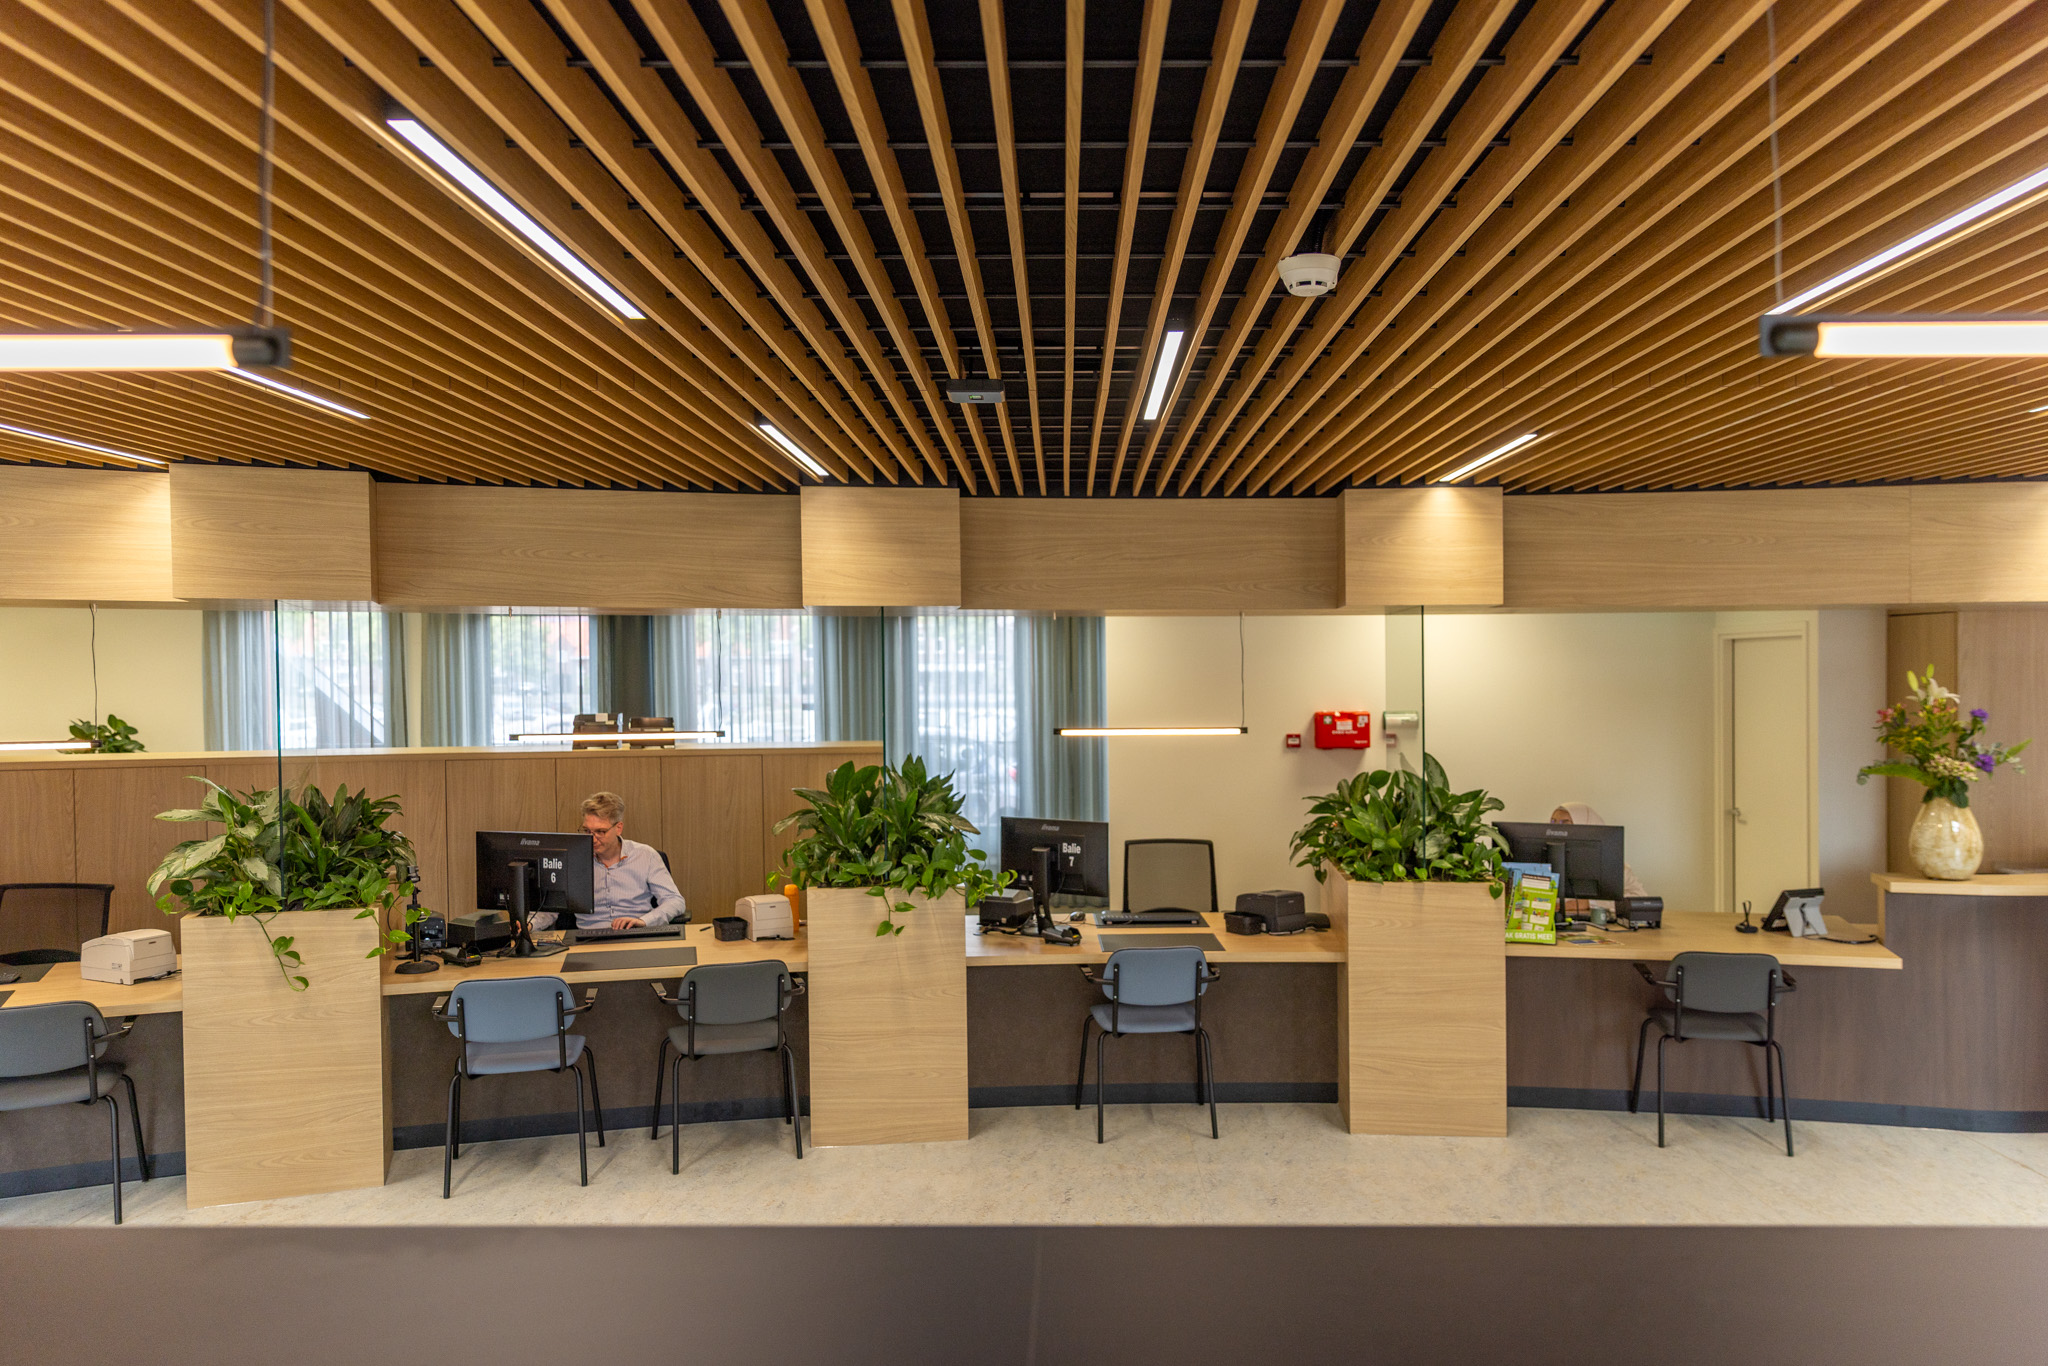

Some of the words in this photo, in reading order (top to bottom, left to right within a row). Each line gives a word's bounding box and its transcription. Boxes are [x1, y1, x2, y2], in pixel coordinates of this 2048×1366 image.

[1062, 842, 1081, 854] Balie
[543, 857, 563, 870] Balie
[1069, 856, 1075, 867] 7
[550, 872, 557, 884] 6
[1514, 932, 1536, 940] GRATIS
